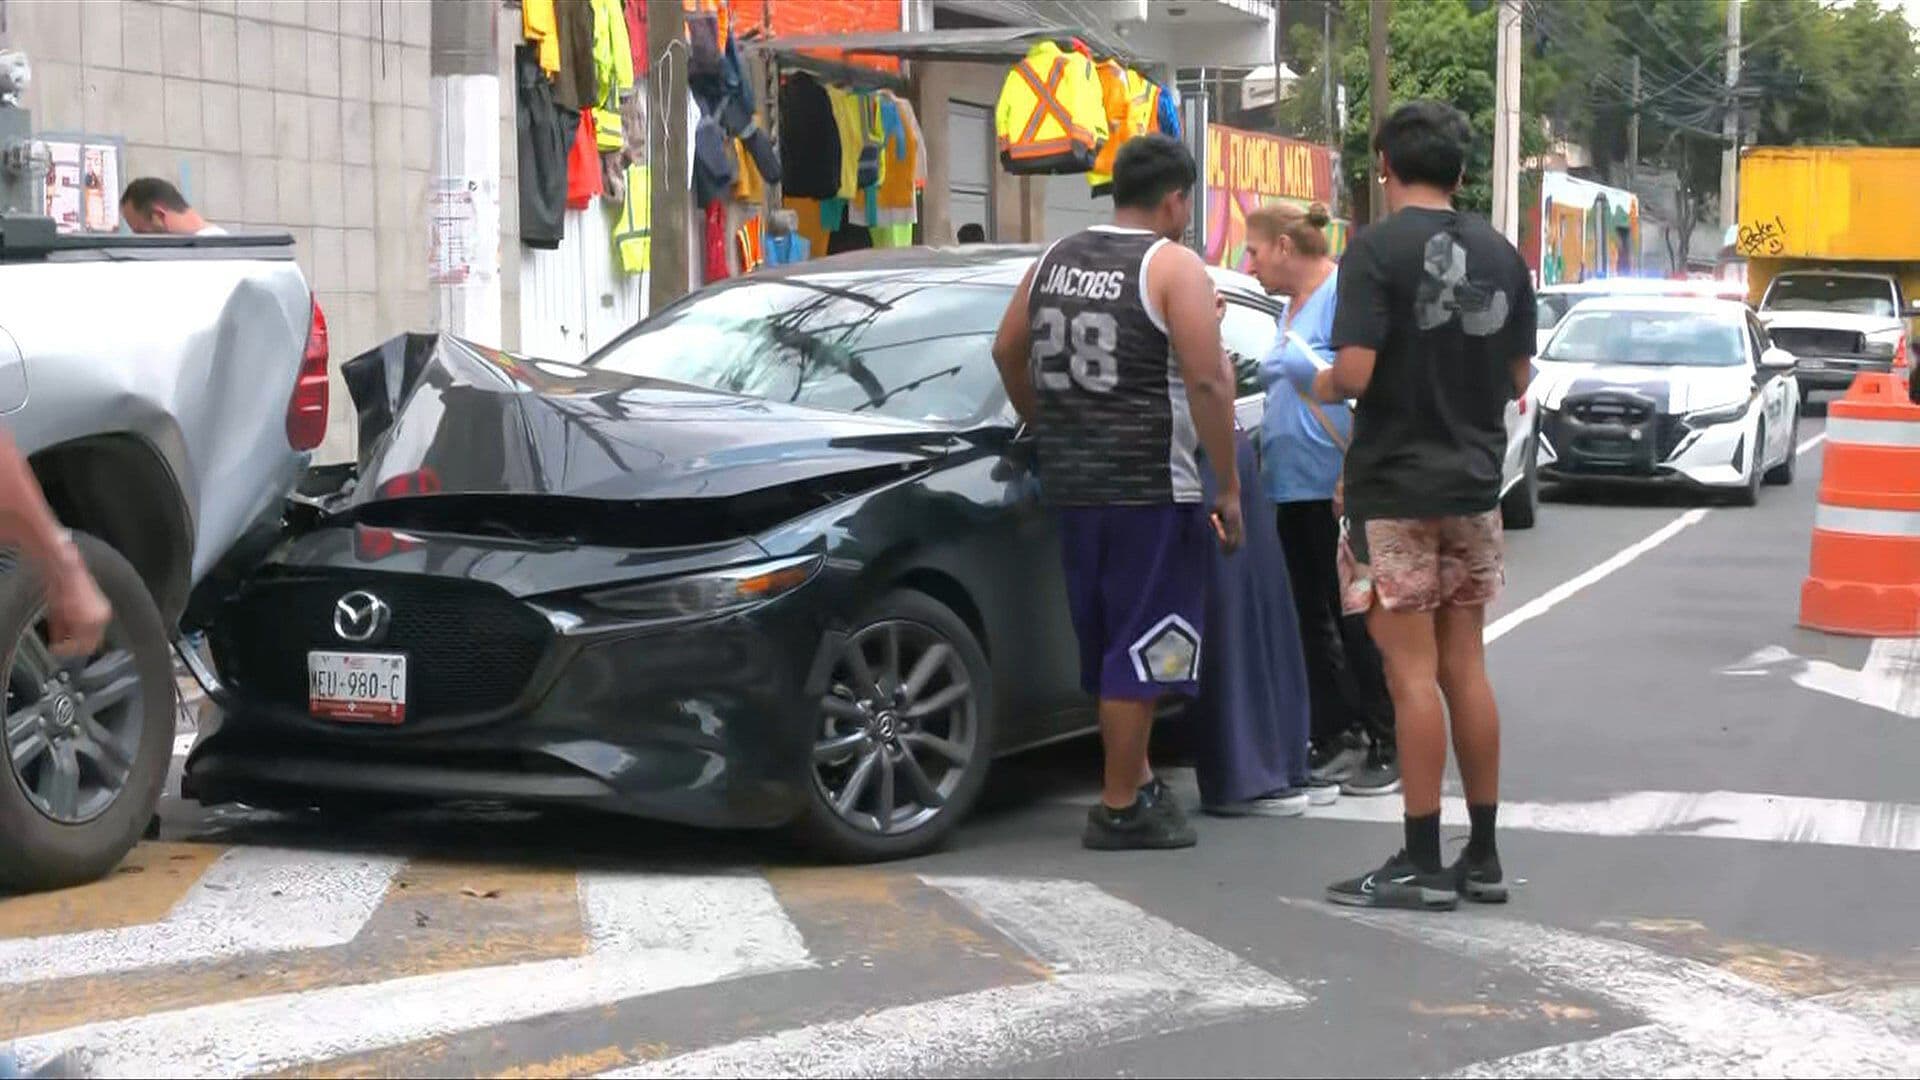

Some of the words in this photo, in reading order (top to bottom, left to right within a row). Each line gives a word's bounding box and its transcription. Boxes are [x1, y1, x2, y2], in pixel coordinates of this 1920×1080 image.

[1284, 144, 1315, 200] MATA
[1040, 263, 1125, 300] JACOBS
[1029, 306, 1119, 393] 28
